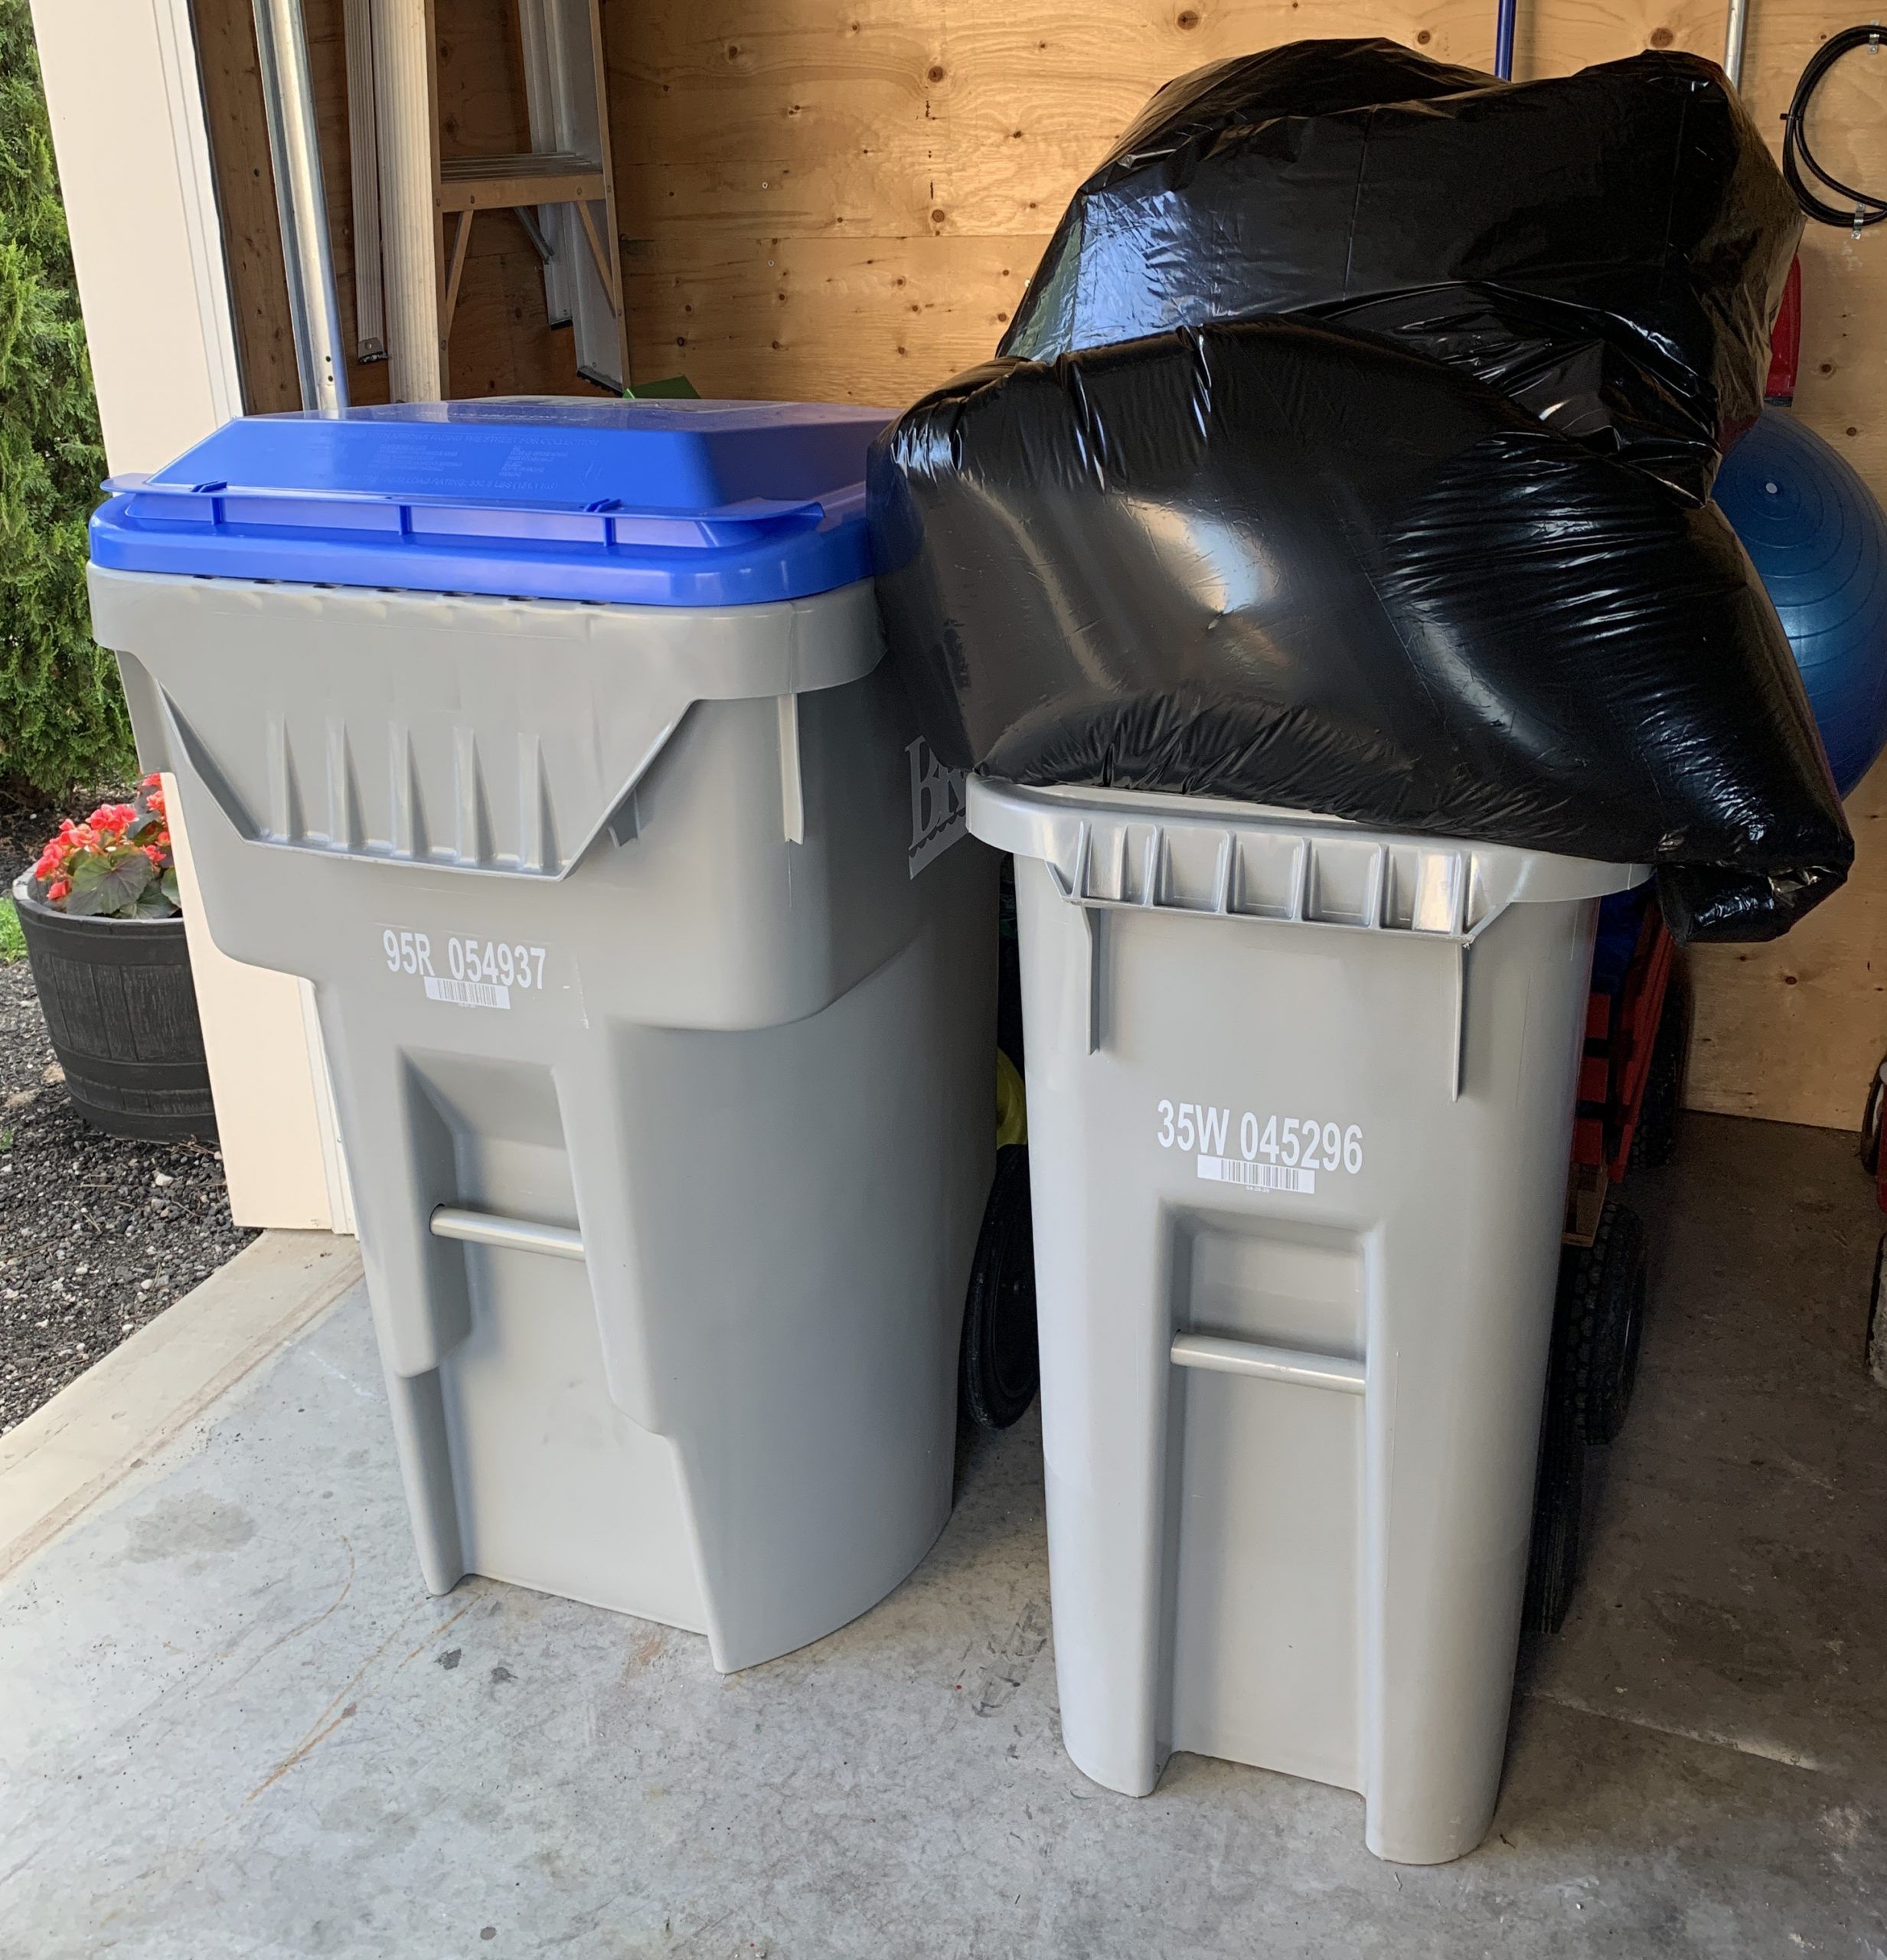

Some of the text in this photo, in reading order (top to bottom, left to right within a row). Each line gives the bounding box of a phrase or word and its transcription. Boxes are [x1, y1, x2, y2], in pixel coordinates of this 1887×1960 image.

[383, 929, 546, 989] 95R 054937
[1157, 1099, 1363, 1174] 35W 045296
